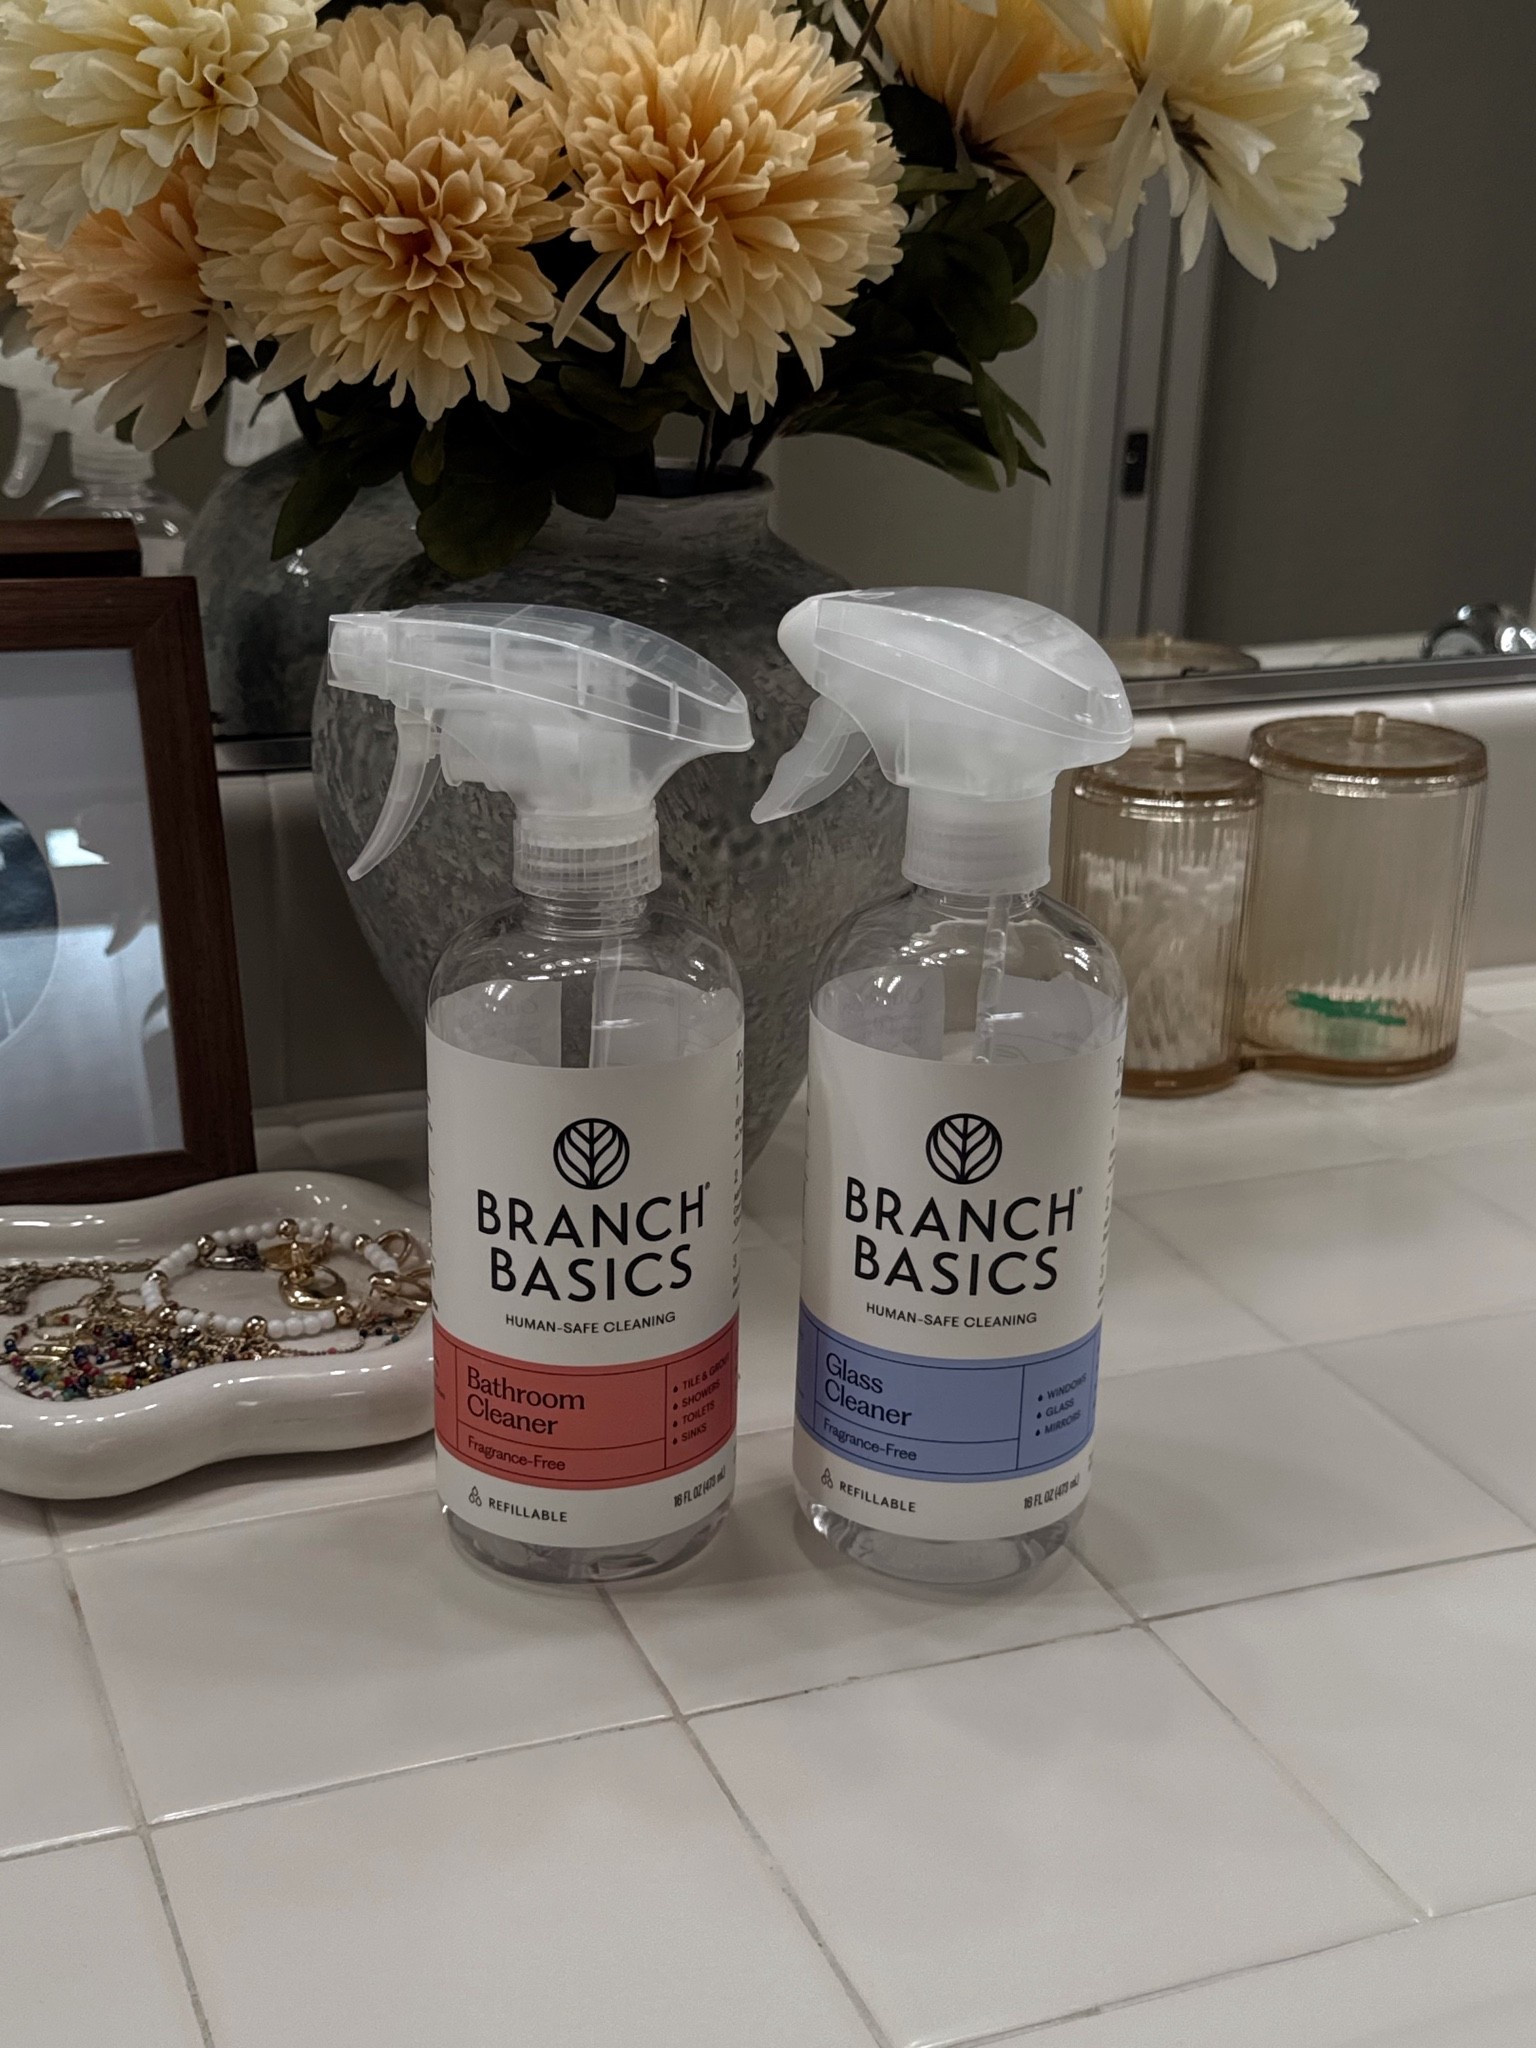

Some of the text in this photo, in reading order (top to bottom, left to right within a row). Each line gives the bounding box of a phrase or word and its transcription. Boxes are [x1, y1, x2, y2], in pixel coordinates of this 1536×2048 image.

[477, 1184, 704, 1248] BRANCH
[846, 1176, 1076, 1242] BRANCH
[490, 1244, 692, 1302] BASICS
[854, 1234, 1058, 1296] BASICS
[505, 1311, 676, 1334] HUMAN-SAFE CLEANING
[866, 1302, 1037, 1328] HUMAN-SAFE CLEANING
[467, 1365, 586, 1410] Bathroom
[682, 1374, 701, 1391] TILE
[702, 1371, 708, 1381] &
[825, 1352, 883, 1394] Glass
[682, 1379, 720, 1408] SHOWERS
[824, 1379, 912, 1426] Cleaner
[1045, 1397, 1074, 1417] GLASS
[467, 1394, 559, 1435] Cleaner
[682, 1400, 715, 1424] TOILETS
[681, 1422, 707, 1442] SINKS
[823, 1418, 918, 1461] Fragrance-Free
[468, 1435, 566, 1471] Fragrance-Free
[488, 1497, 568, 1523] REFILLABLE
[839, 1481, 917, 1513] REFILLABLE
